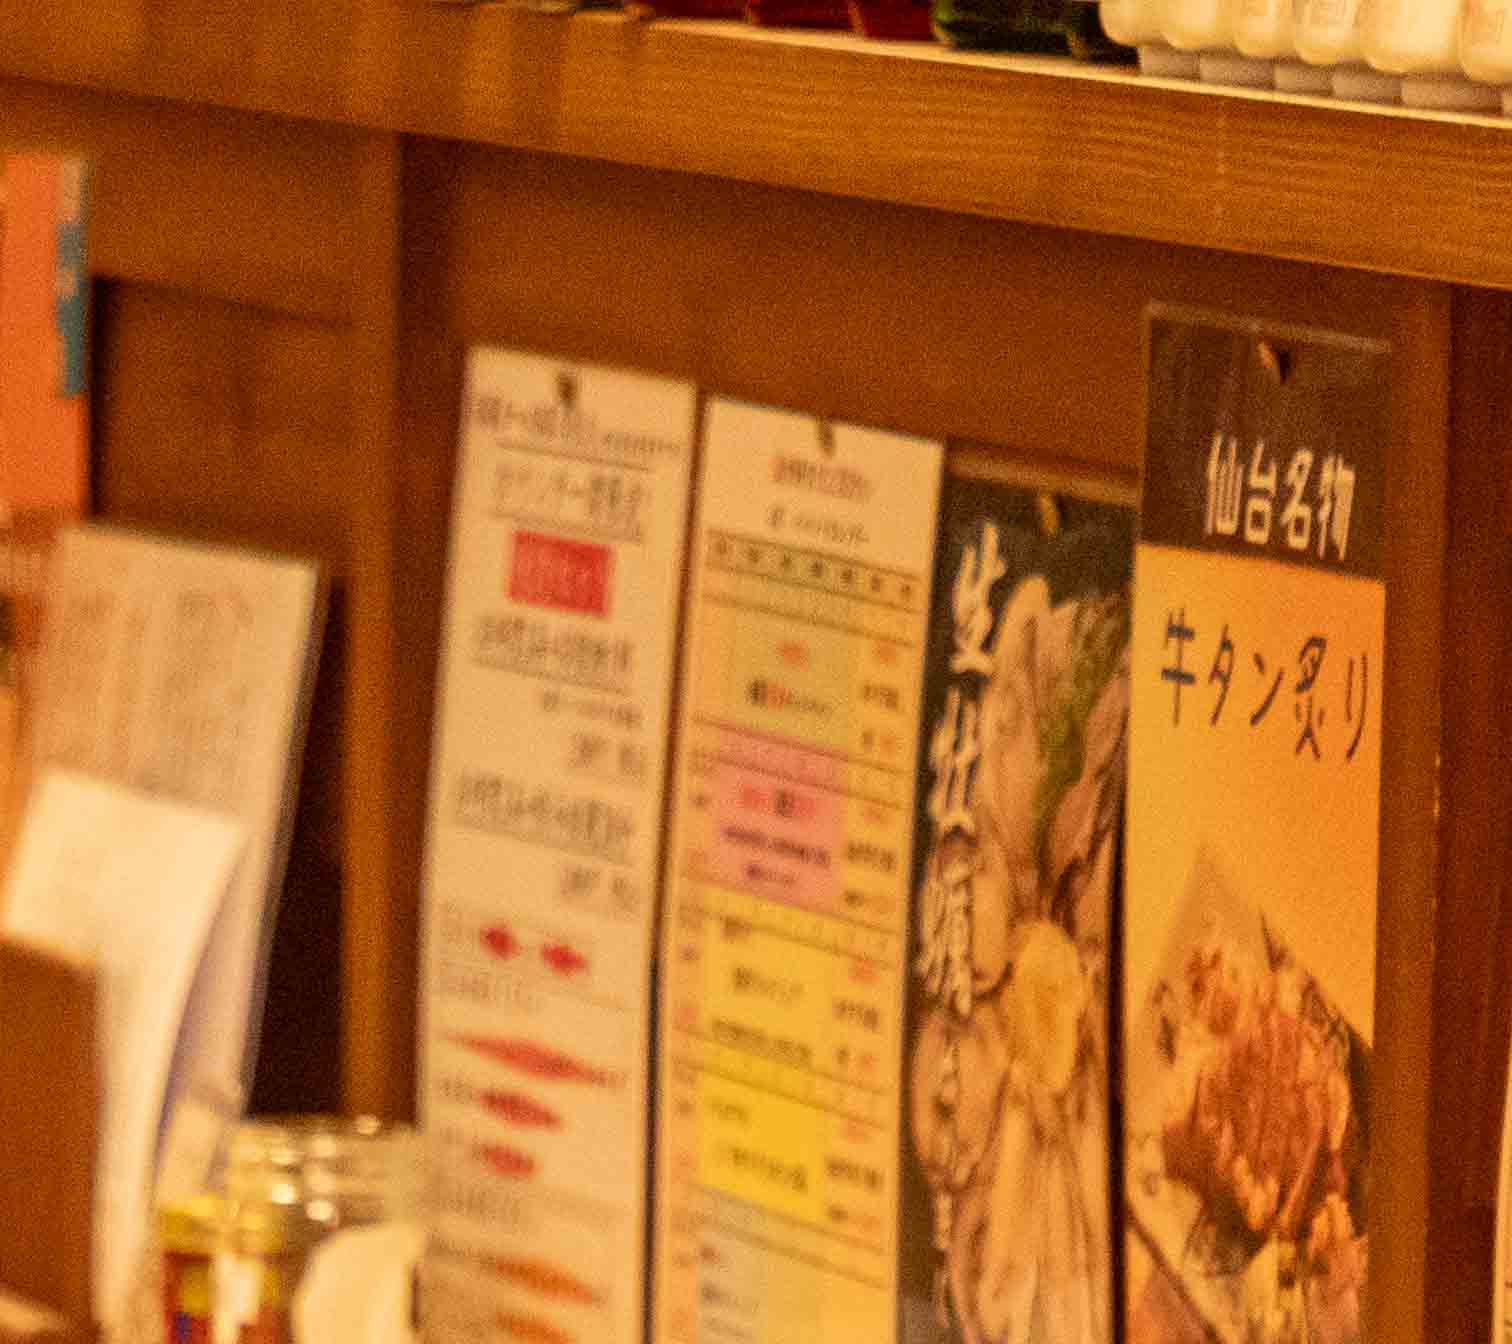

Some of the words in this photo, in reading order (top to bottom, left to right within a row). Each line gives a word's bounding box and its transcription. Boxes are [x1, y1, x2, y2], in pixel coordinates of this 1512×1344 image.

[1205, 433, 1356, 562] 仙台名物
[1159, 611, 1370, 763] 牛タン炙り
